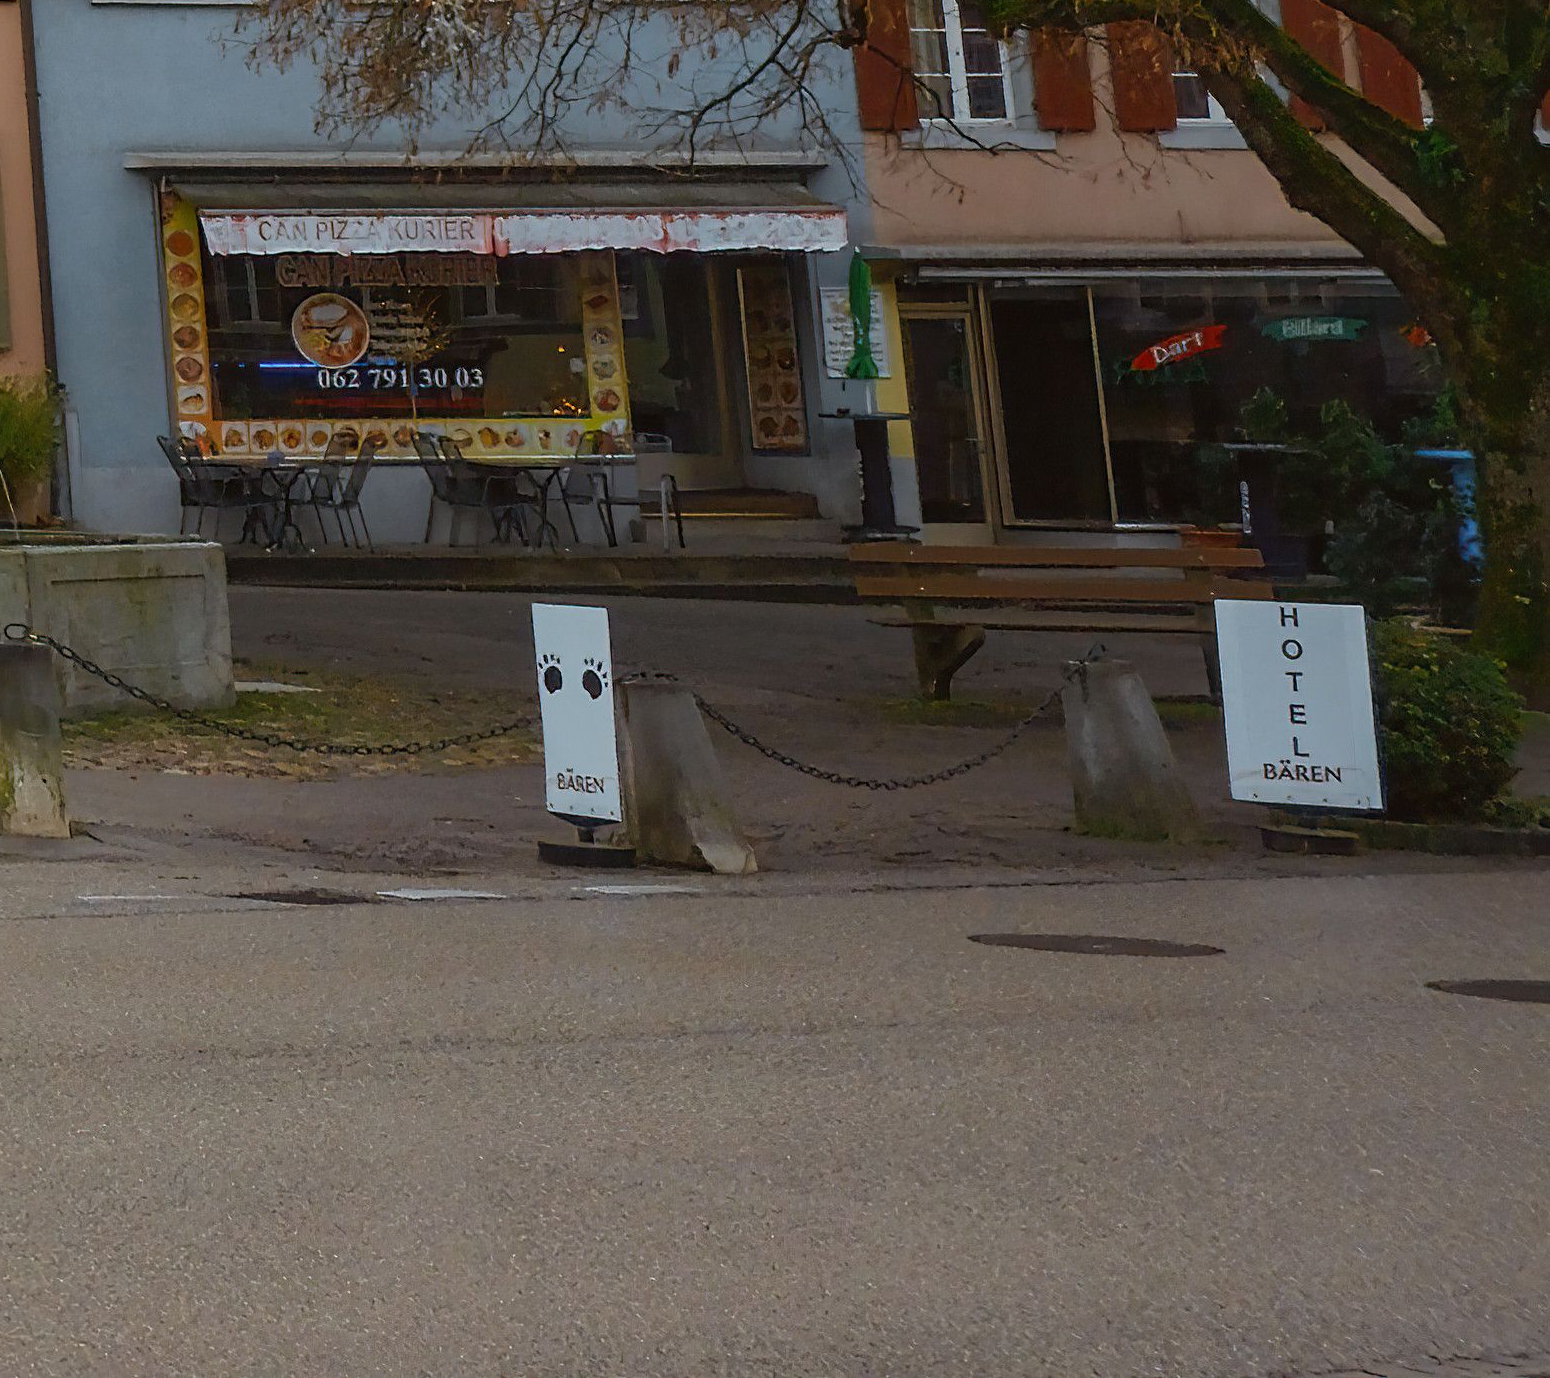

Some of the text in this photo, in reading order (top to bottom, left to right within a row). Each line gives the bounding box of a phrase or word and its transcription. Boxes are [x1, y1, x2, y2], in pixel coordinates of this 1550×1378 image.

[258, 219, 476, 241] CAN PIZZA KURIER
[1150, 331, 1204, 364] Dart
[317, 368, 485, 389] 062 791 30 03
[1279, 606, 1310, 758] HOTEL
[556, 767, 605, 794] BÄREN
[1262, 759, 1343, 783] BÄREN
